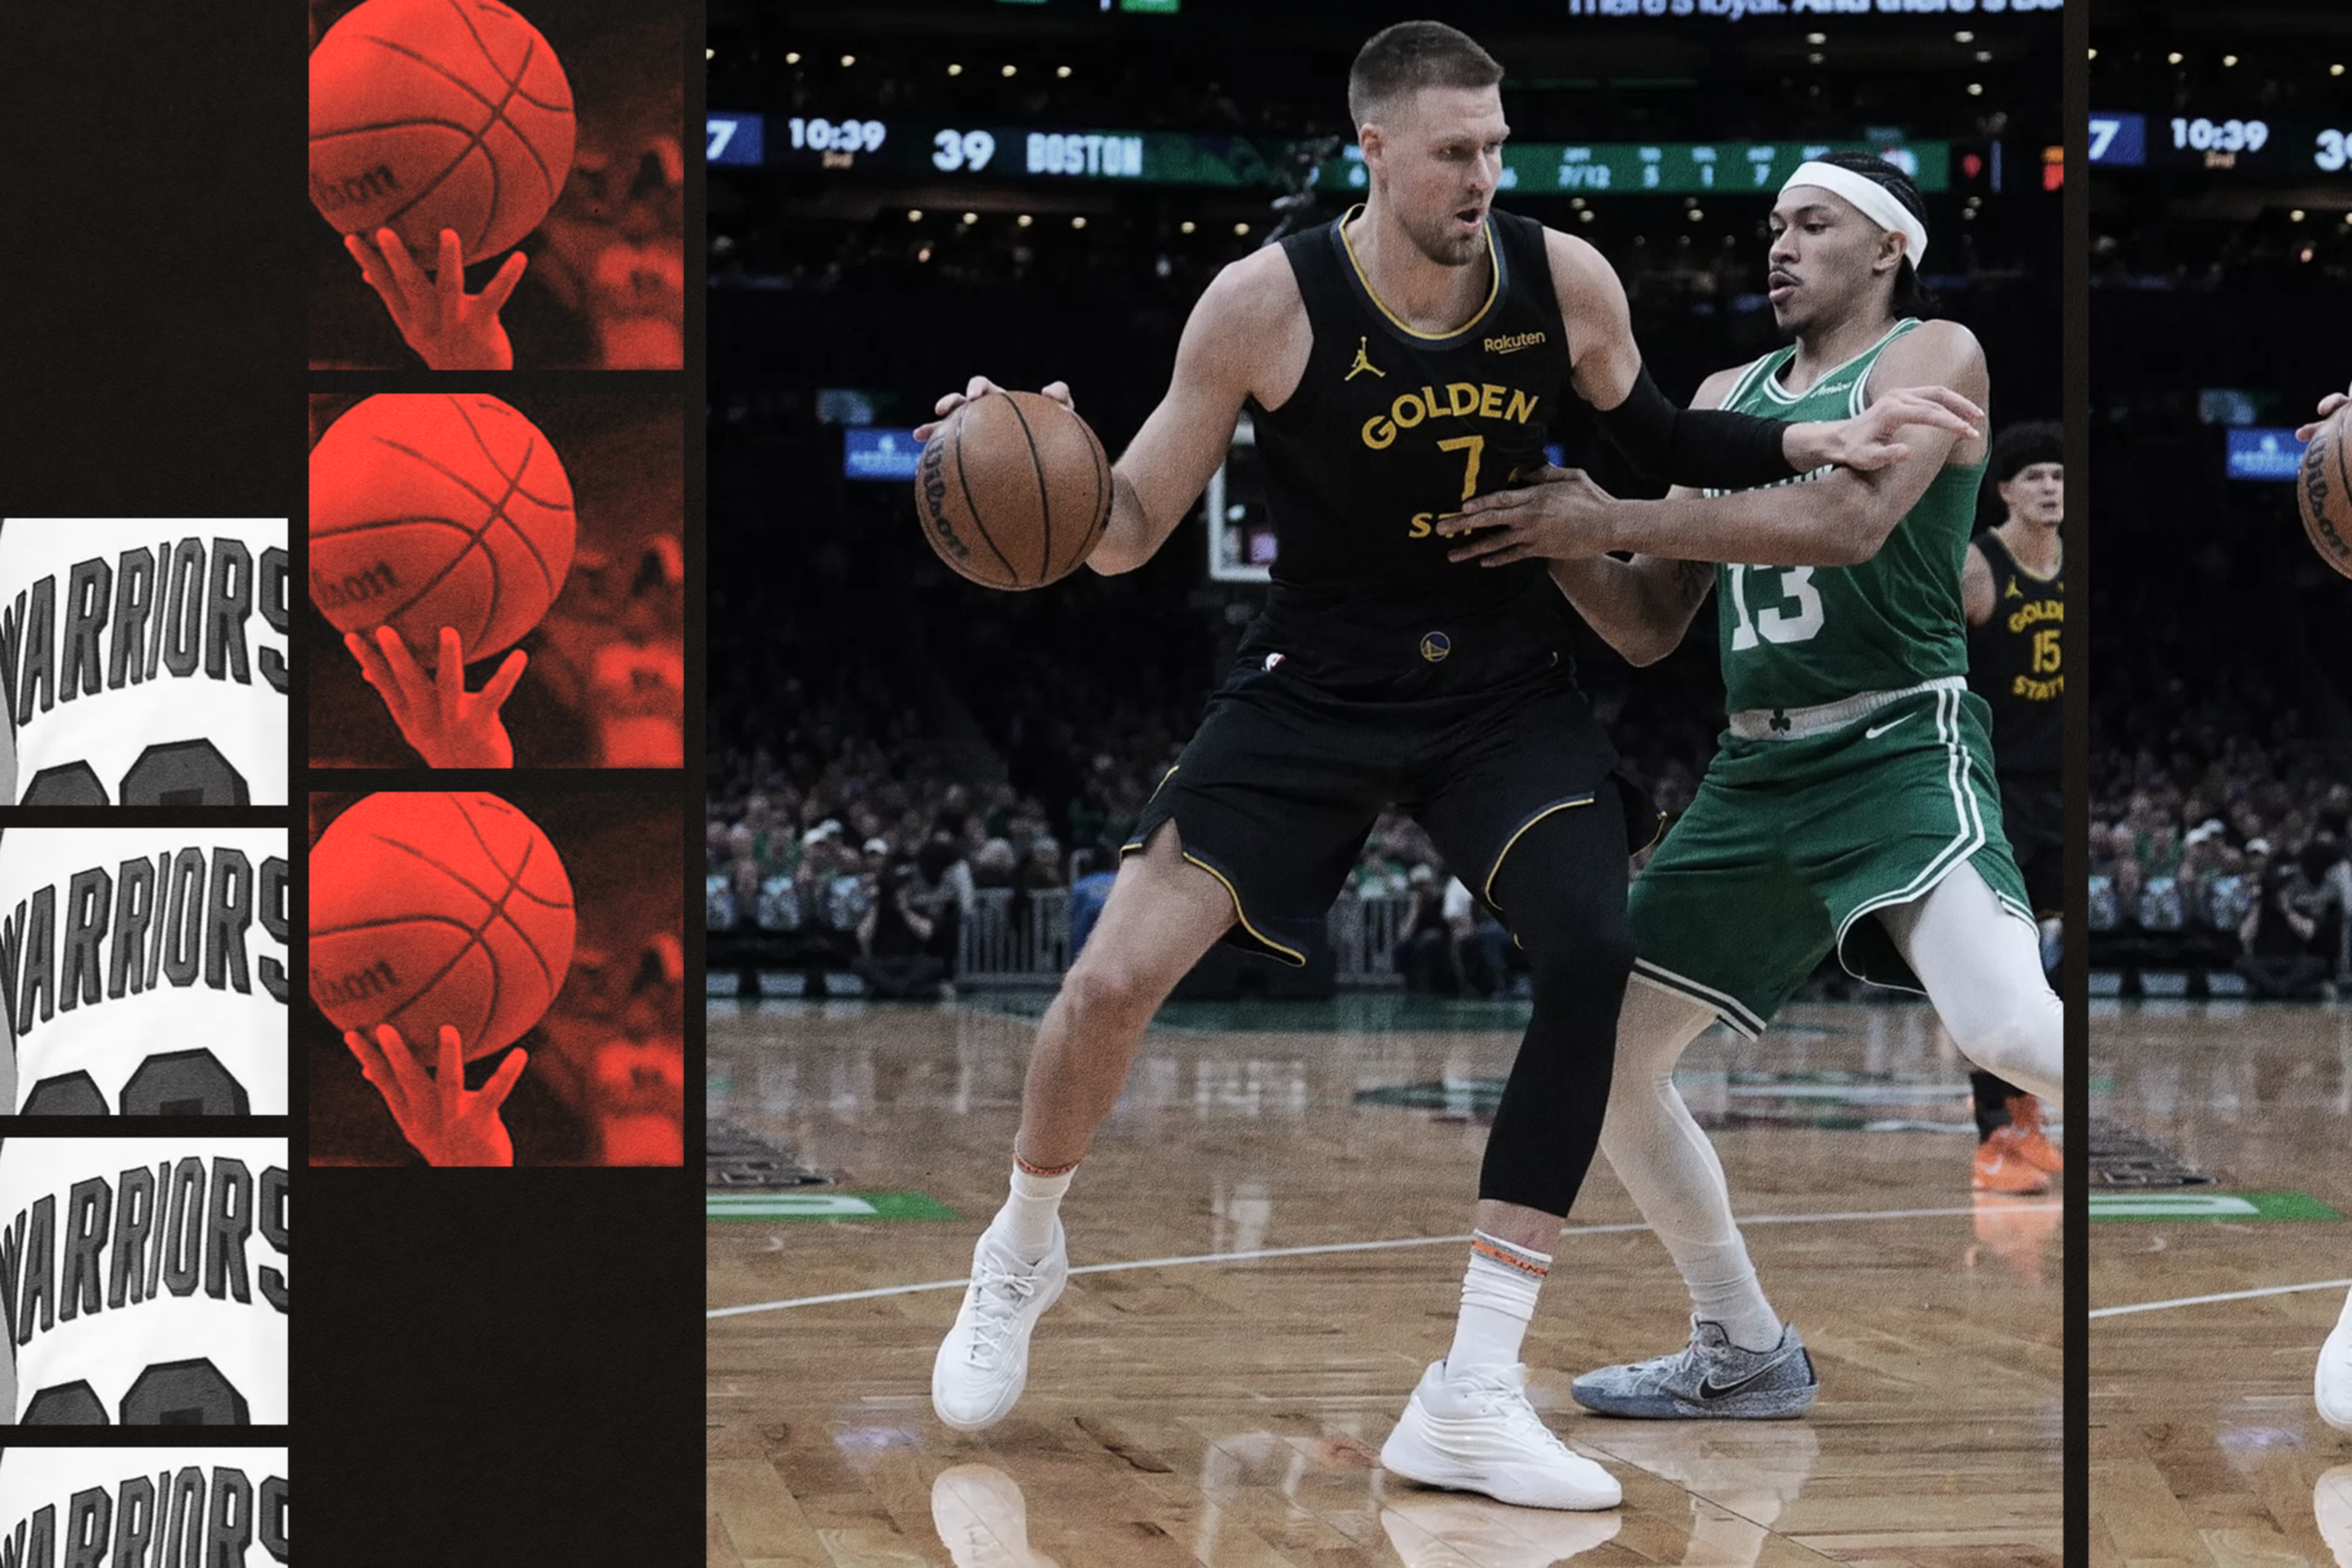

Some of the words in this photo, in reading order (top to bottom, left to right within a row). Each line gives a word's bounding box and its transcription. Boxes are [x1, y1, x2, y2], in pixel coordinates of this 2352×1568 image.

[1569, 0, 1694, 16] Theres
[789, 118, 887, 153] 10:39
[932, 129, 995, 172] 39
[1026, 132, 1143, 176] BOSTON
[2171, 118, 2269, 153] 10:39
[2314, 129, 2352, 172] 3
[1483, 331, 1546, 353] Rakuten
[1362, 382, 1539, 450] GOLDEN
[1436, 435, 1485, 501] 7
[1727, 563, 1825, 651] 13
[2033, 628, 2062, 673] 15
